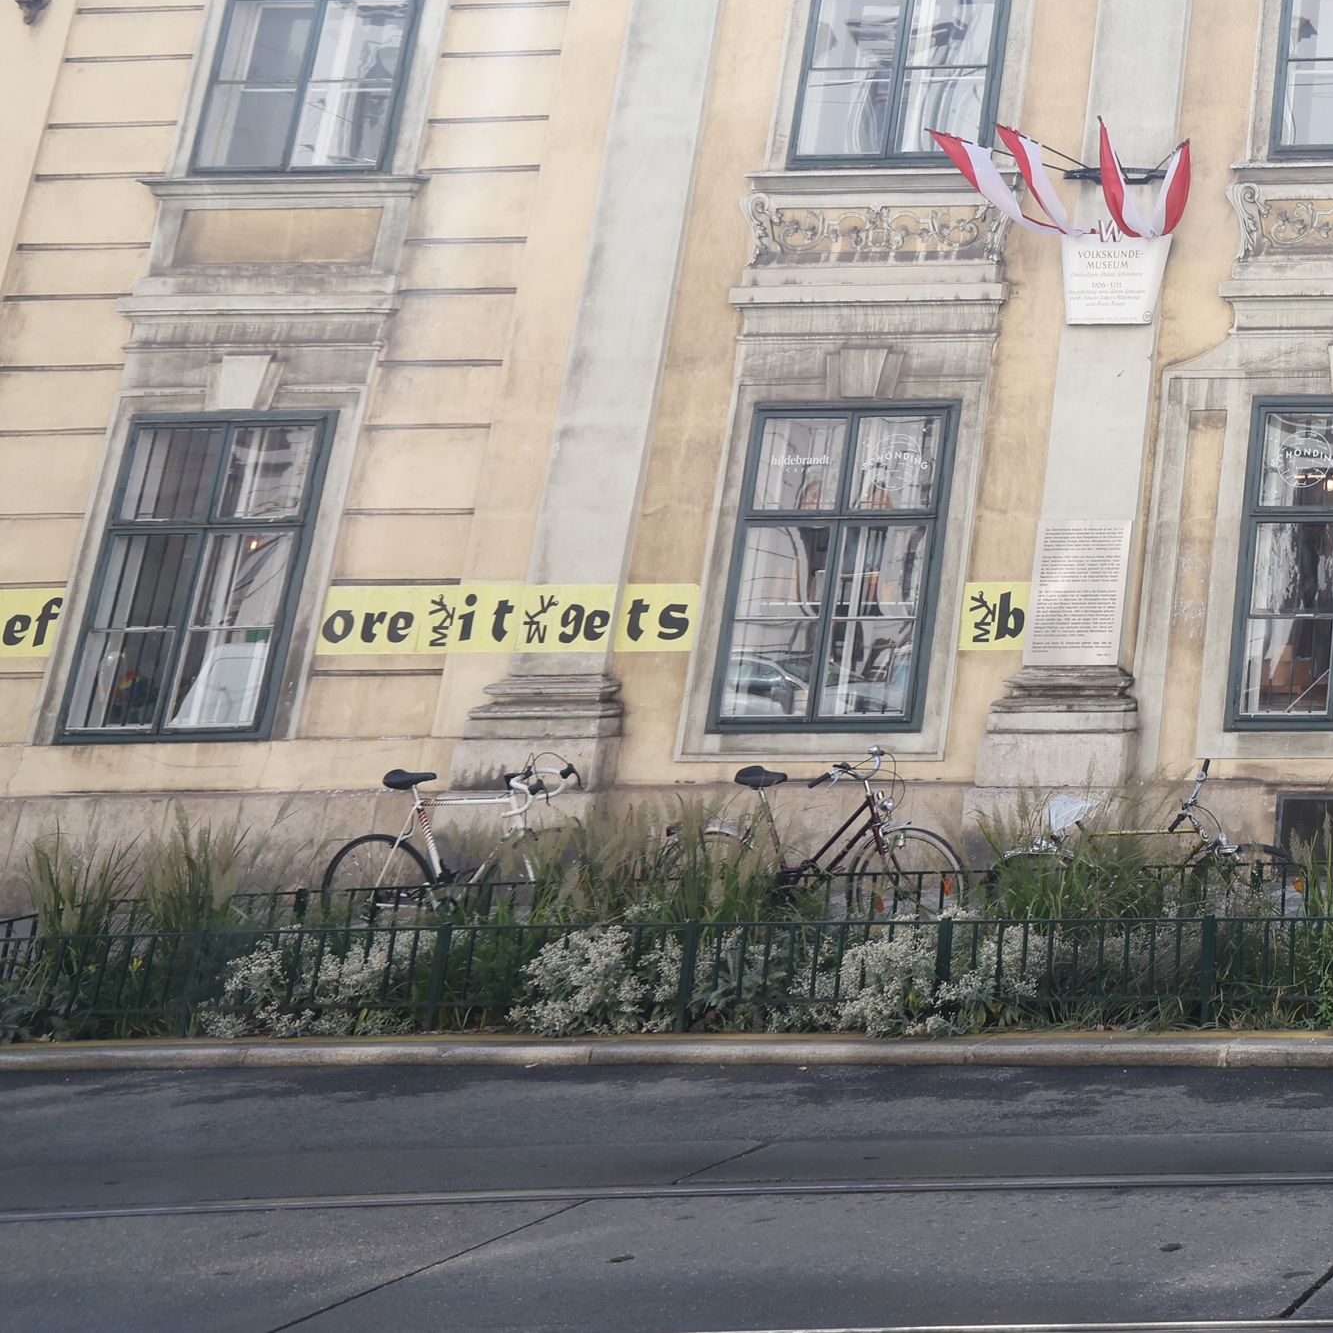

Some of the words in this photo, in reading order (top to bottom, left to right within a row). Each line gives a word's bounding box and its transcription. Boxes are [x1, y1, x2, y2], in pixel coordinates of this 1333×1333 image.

[1077, 250, 1144, 259] VOLKSKUNDE-
[1086, 261, 1129, 270] MUSEUM
[771, 455, 830, 466] hildebrandt
[458, 593, 514, 642] it
[558, 598, 690, 644] gets
[994, 591, 1025, 641] b
